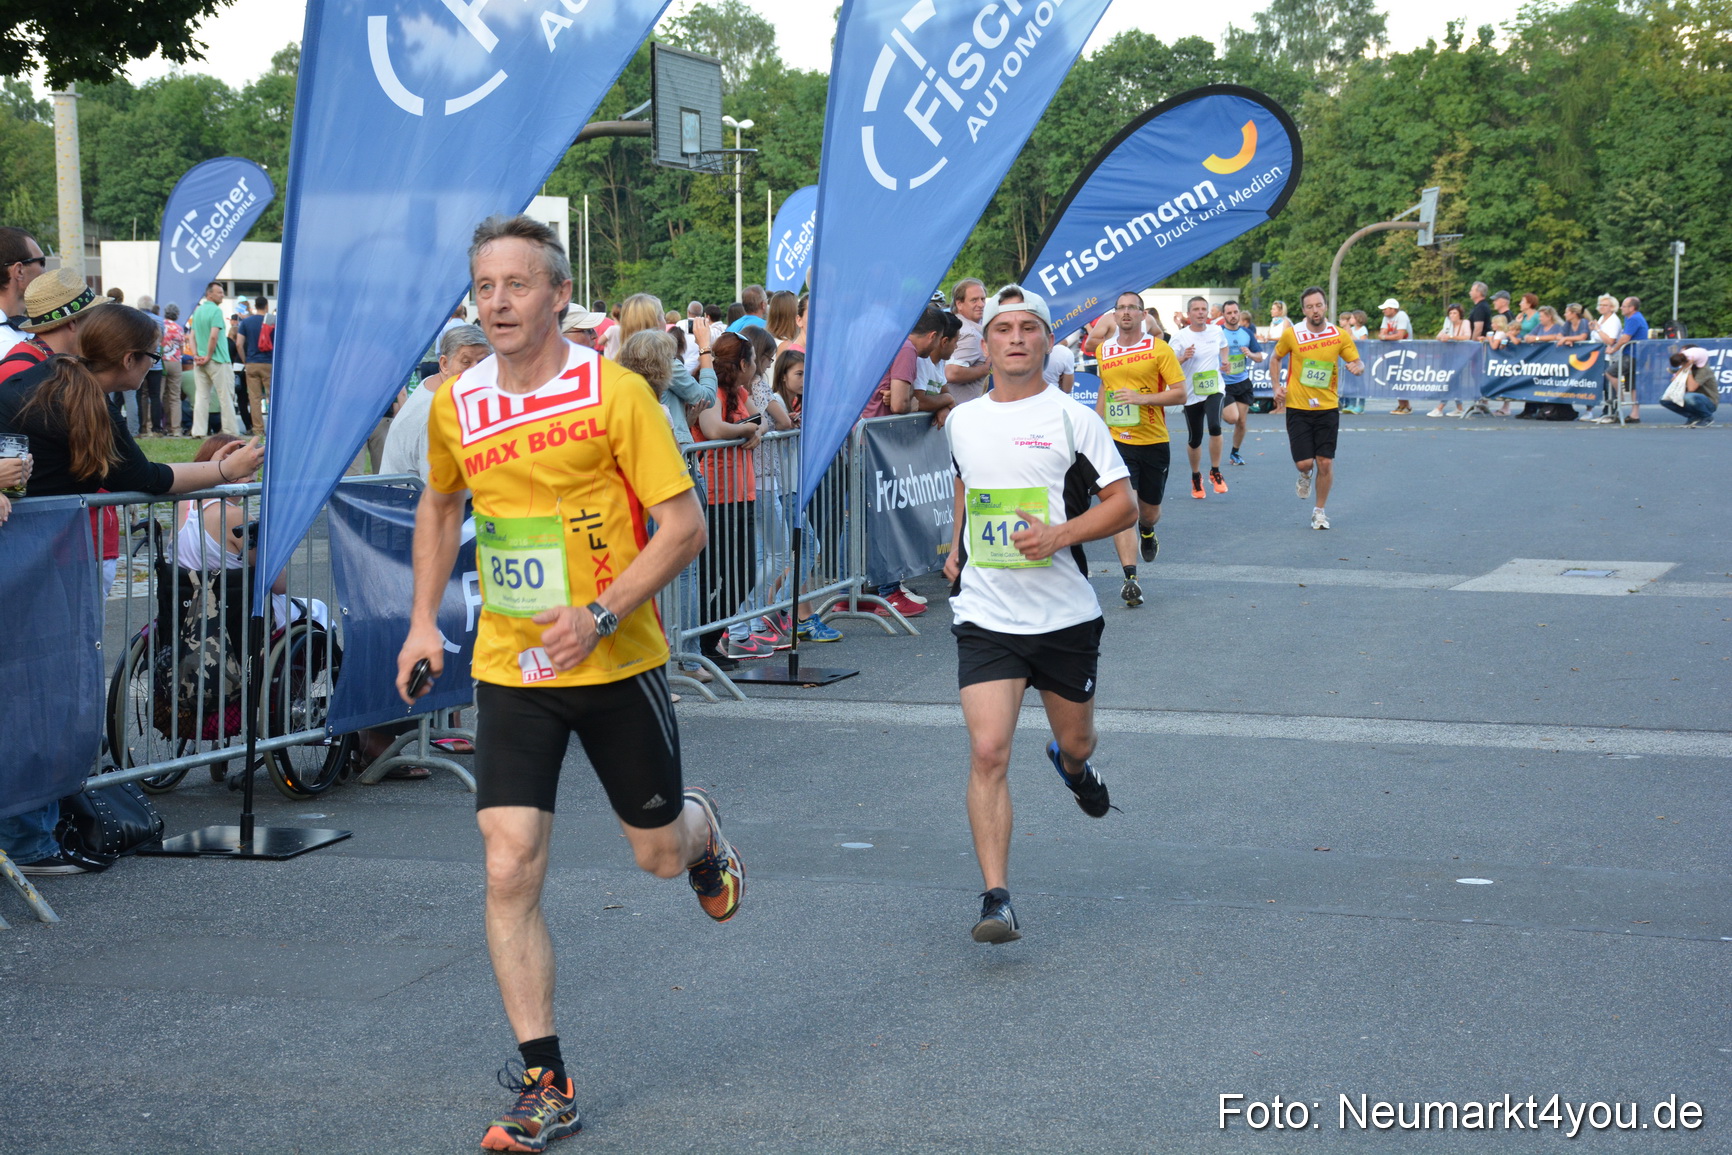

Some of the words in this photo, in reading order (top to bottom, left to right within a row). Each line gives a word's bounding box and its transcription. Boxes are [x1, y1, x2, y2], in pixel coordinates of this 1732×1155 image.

[966, 0, 1064, 144] AUTOMO
[1154, 216, 1197, 248] Druck
[1199, 201, 1228, 222] und
[1228, 165, 1283, 207] Medien
[185, 176, 249, 259] Fischer
[207, 192, 257, 259] AUTOMOBILE
[1038, 180, 1219, 296] Frischmann
[1298, 344, 1318, 353] MAX
[1321, 339, 1341, 348] BÖGL
[1102, 359, 1123, 371] MAX
[1127, 353, 1155, 364] BÖGL
[1487, 360, 1570, 378] Frischmann
[1307, 370, 1326, 381] 842
[1386, 365, 1455, 382] Fischer
[1533, 377, 1554, 386] Druck
[1554, 378, 1569, 387] und
[1199, 379, 1214, 389] 438
[1392, 384, 1449, 392] AUTOMOBILE
[1109, 405, 1131, 417] 851
[464, 439, 520, 478] MAX
[528, 417, 607, 454] BÖGL
[875, 464, 955, 513] Frischman
[491, 556, 545, 590] 850
